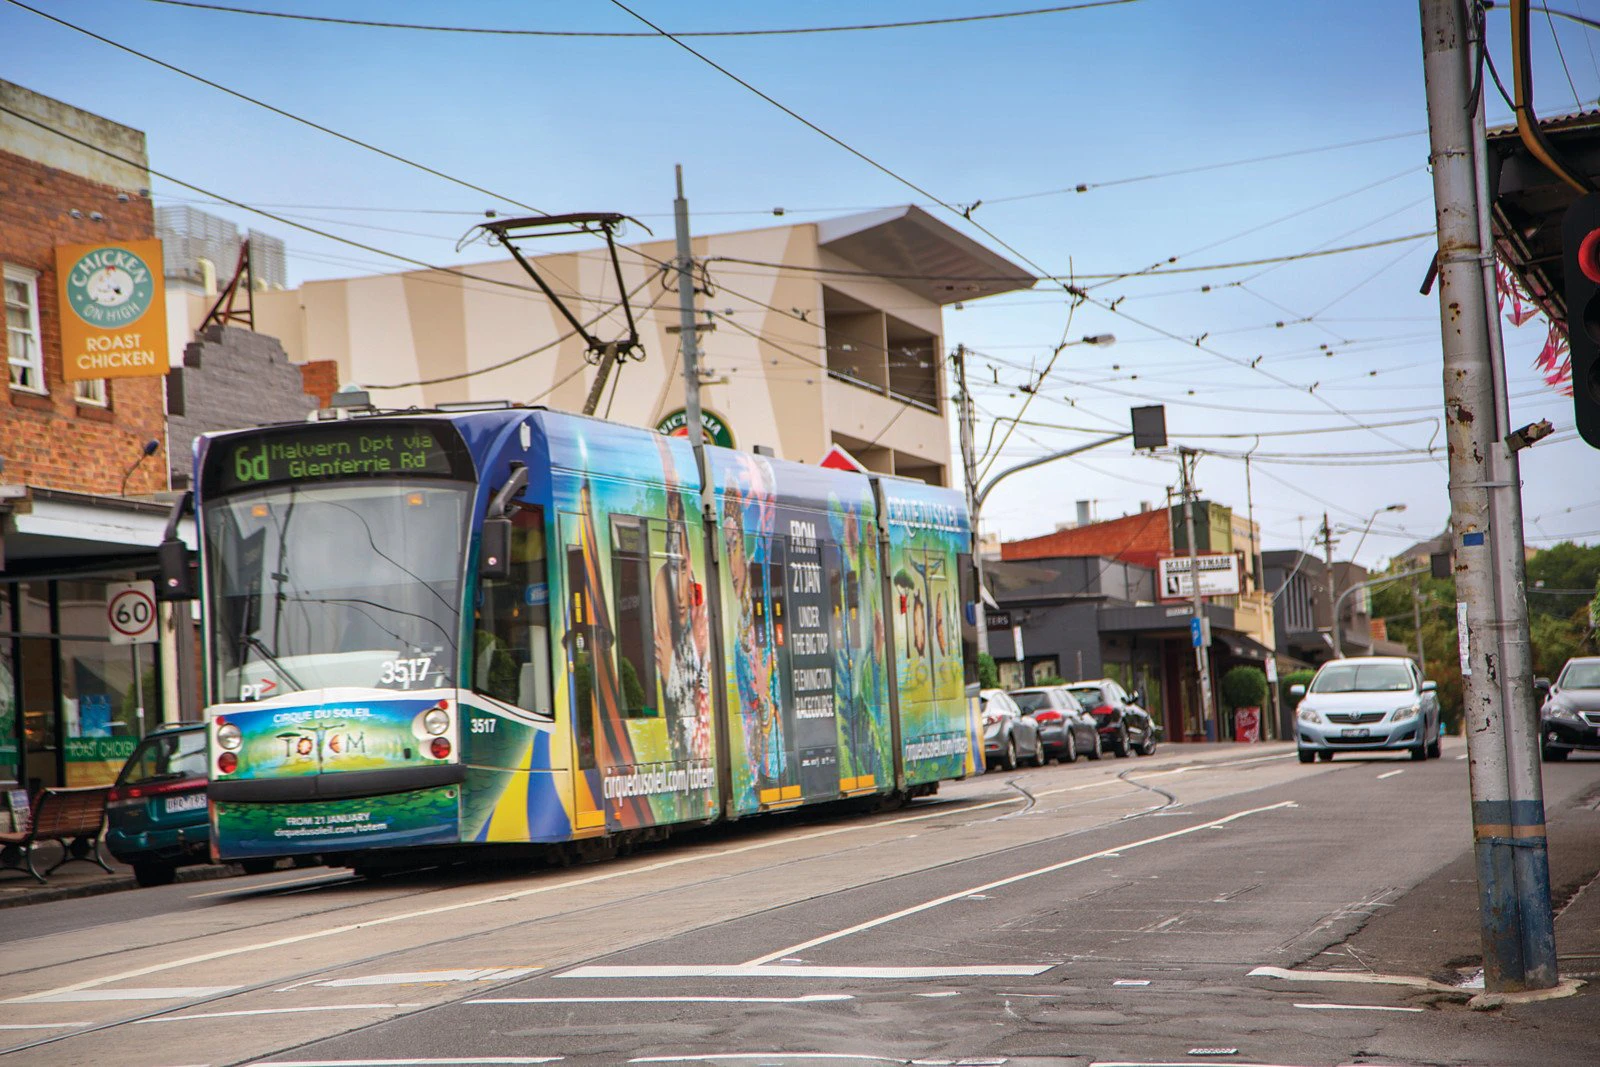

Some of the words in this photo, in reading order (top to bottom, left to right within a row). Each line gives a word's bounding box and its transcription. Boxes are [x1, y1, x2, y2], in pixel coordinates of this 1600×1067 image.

[71, 249, 149, 288] CHICKEN
[83, 303, 104, 321] ON
[107, 301, 141, 321] HIGH
[86, 333, 141, 353] ROAST
[76, 350, 155, 370] CHICKEN
[271, 442, 350, 461] Malvern
[360, 435, 394, 453] Dpt
[403, 433, 433, 449] via
[234, 445, 270, 482] 6d
[288, 455, 391, 478] Glenferrie
[400, 451, 426, 469] Rd
[789, 519, 817, 555] FROM
[804, 562, 821, 594] JAN
[117, 601, 149, 624] 60
[798, 605, 821, 629] UNDER
[792, 633, 806, 655] THE
[816, 633, 829, 655] TOP
[380, 657, 431, 685] 3517
[794, 667, 833, 692] FLEMINGTON
[273, 709, 313, 724] CIRQUE
[314, 708, 332, 720] DU
[333, 706, 370, 719] SOLEIL
[470, 717, 497, 735] 3517
[70, 741, 97, 757] ROAST
[604, 760, 714, 807] cirquedusoleil.com/totem
[274, 822, 388, 839] cirquedusoleil.com/totem
[286, 816, 312, 826] FROM
[314, 816, 326, 825] 21
[327, 812, 371, 824] JANUARY
